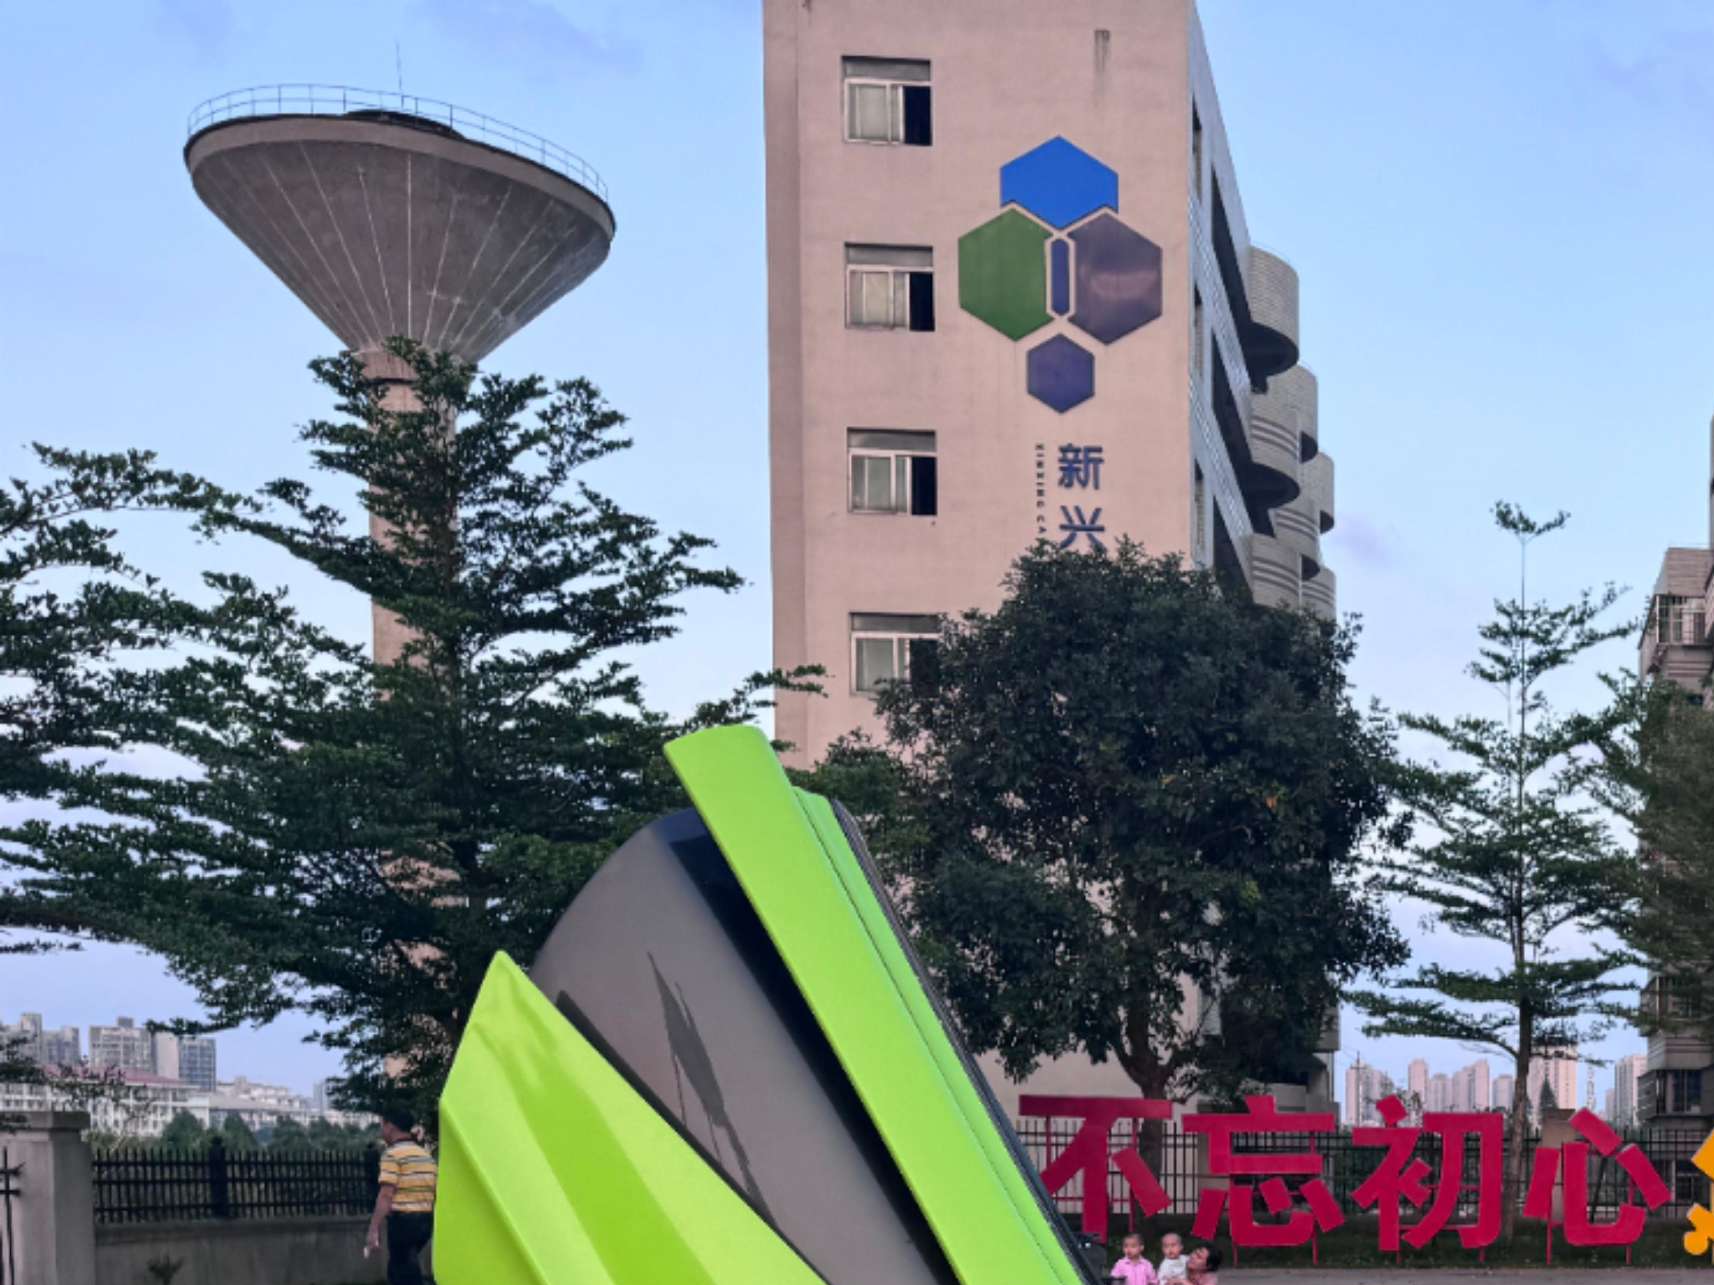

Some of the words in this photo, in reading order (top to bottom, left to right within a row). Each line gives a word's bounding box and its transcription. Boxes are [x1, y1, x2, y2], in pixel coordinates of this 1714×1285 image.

[1058, 443, 1107, 556] 新兴
[1019, 1094, 1673, 1252] 不忘初心
